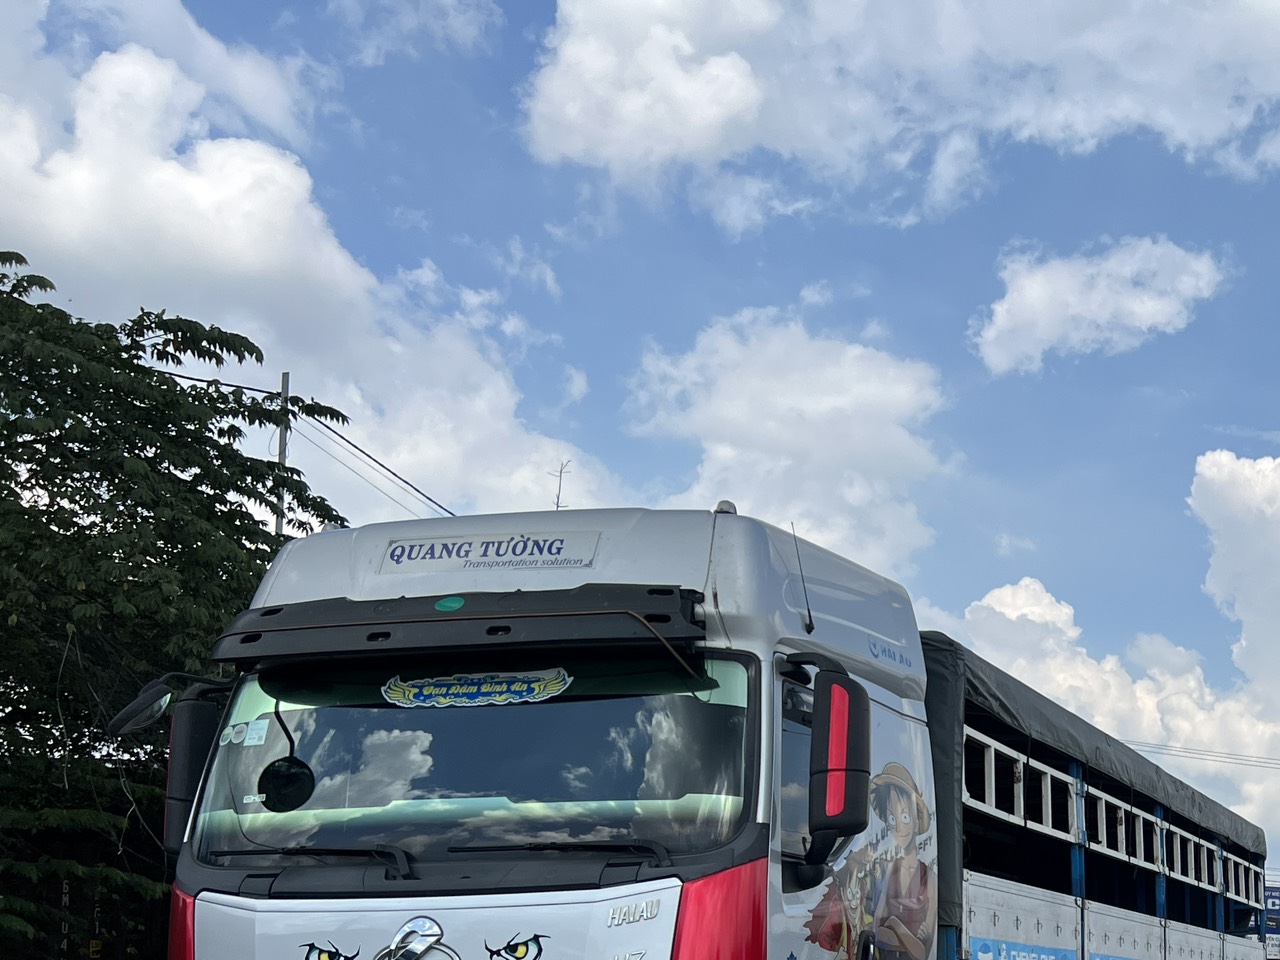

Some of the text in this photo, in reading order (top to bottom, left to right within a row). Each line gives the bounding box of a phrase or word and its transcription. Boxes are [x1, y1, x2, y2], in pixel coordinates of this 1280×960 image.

[389, 534, 565, 565] QUANG TƯỜNG
[463, 557, 583, 569] Transportation solution
